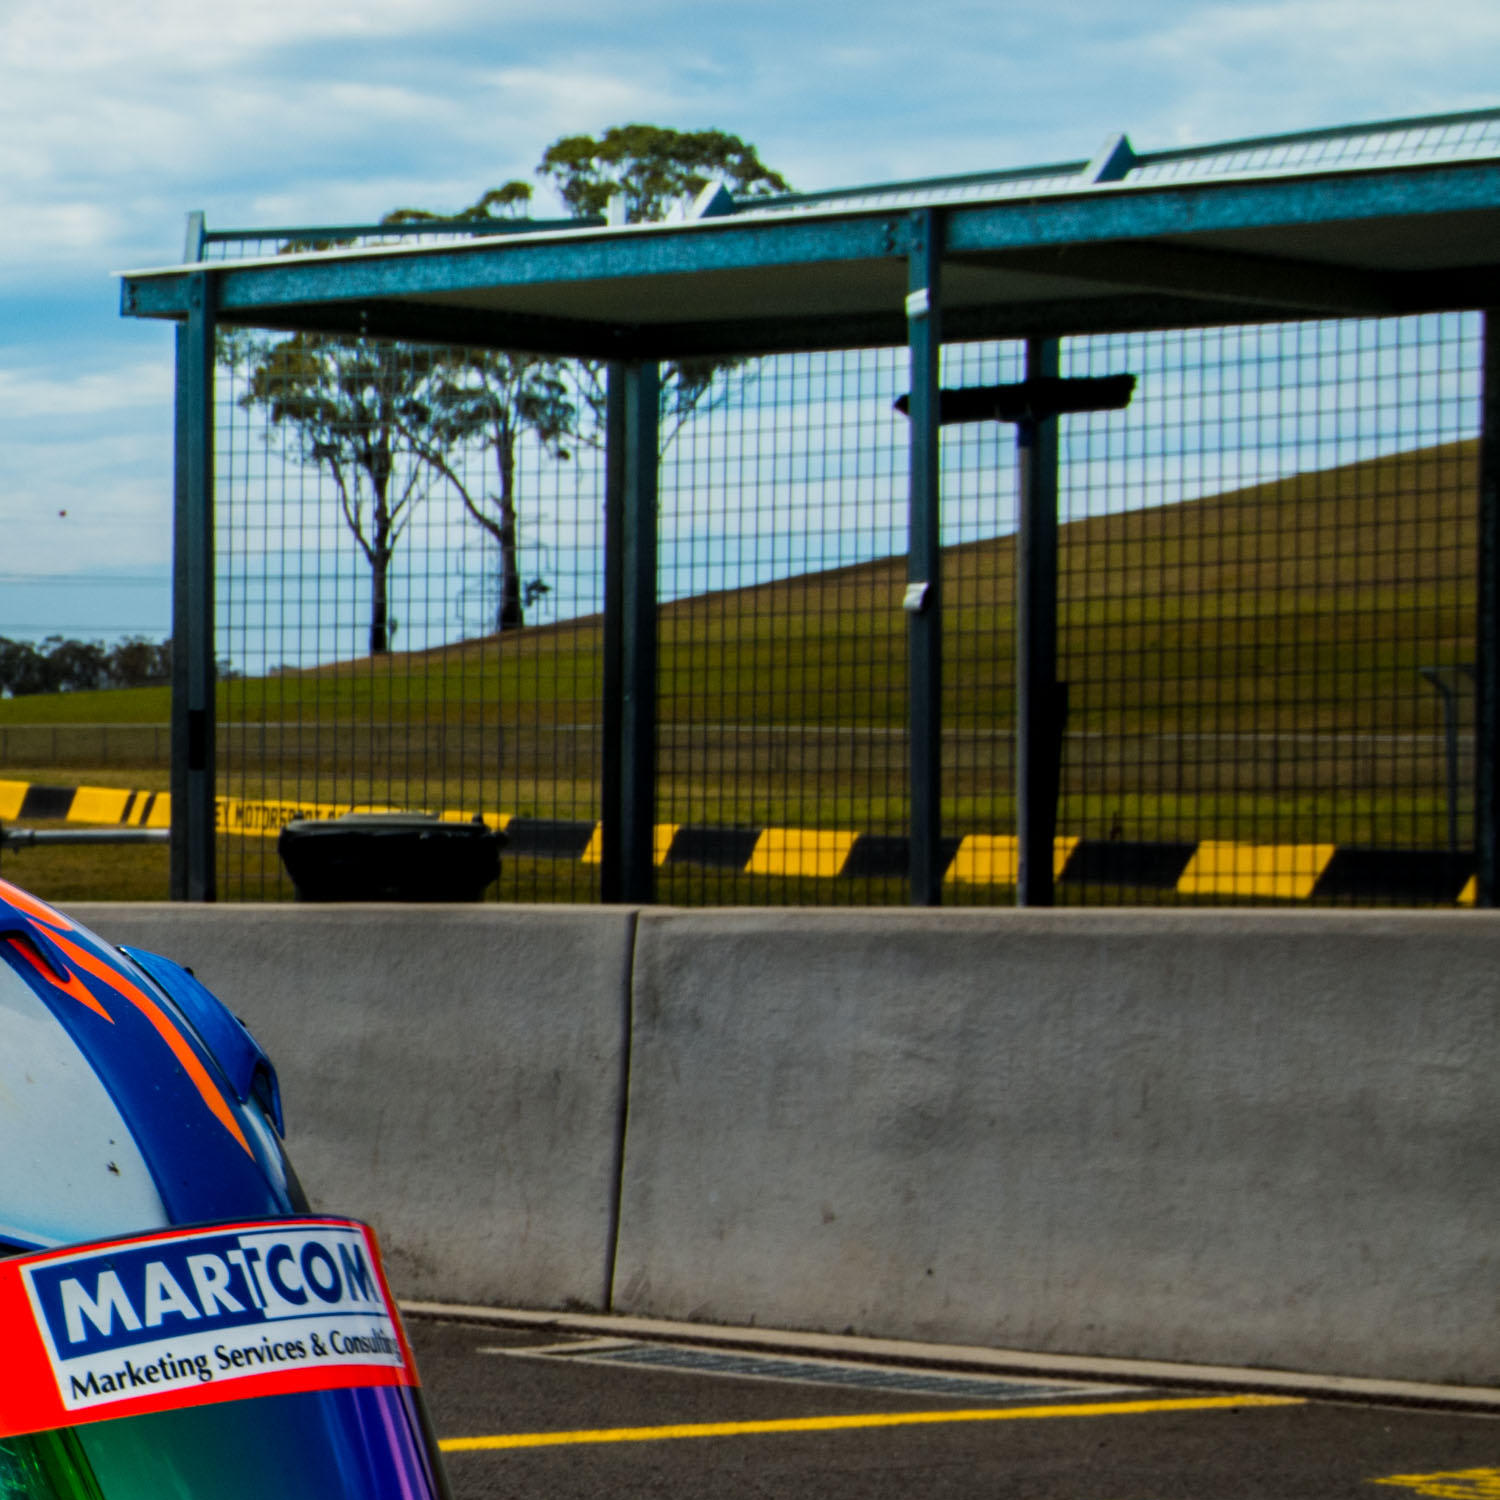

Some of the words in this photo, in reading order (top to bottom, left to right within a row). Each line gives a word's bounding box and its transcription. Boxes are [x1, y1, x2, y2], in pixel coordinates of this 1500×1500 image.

[59, 1240, 382, 1344] MARTCOM
[70, 1352, 213, 1400] Marketing
[215, 1335, 306, 1369] Services
[310, 1332, 329, 1357] &
